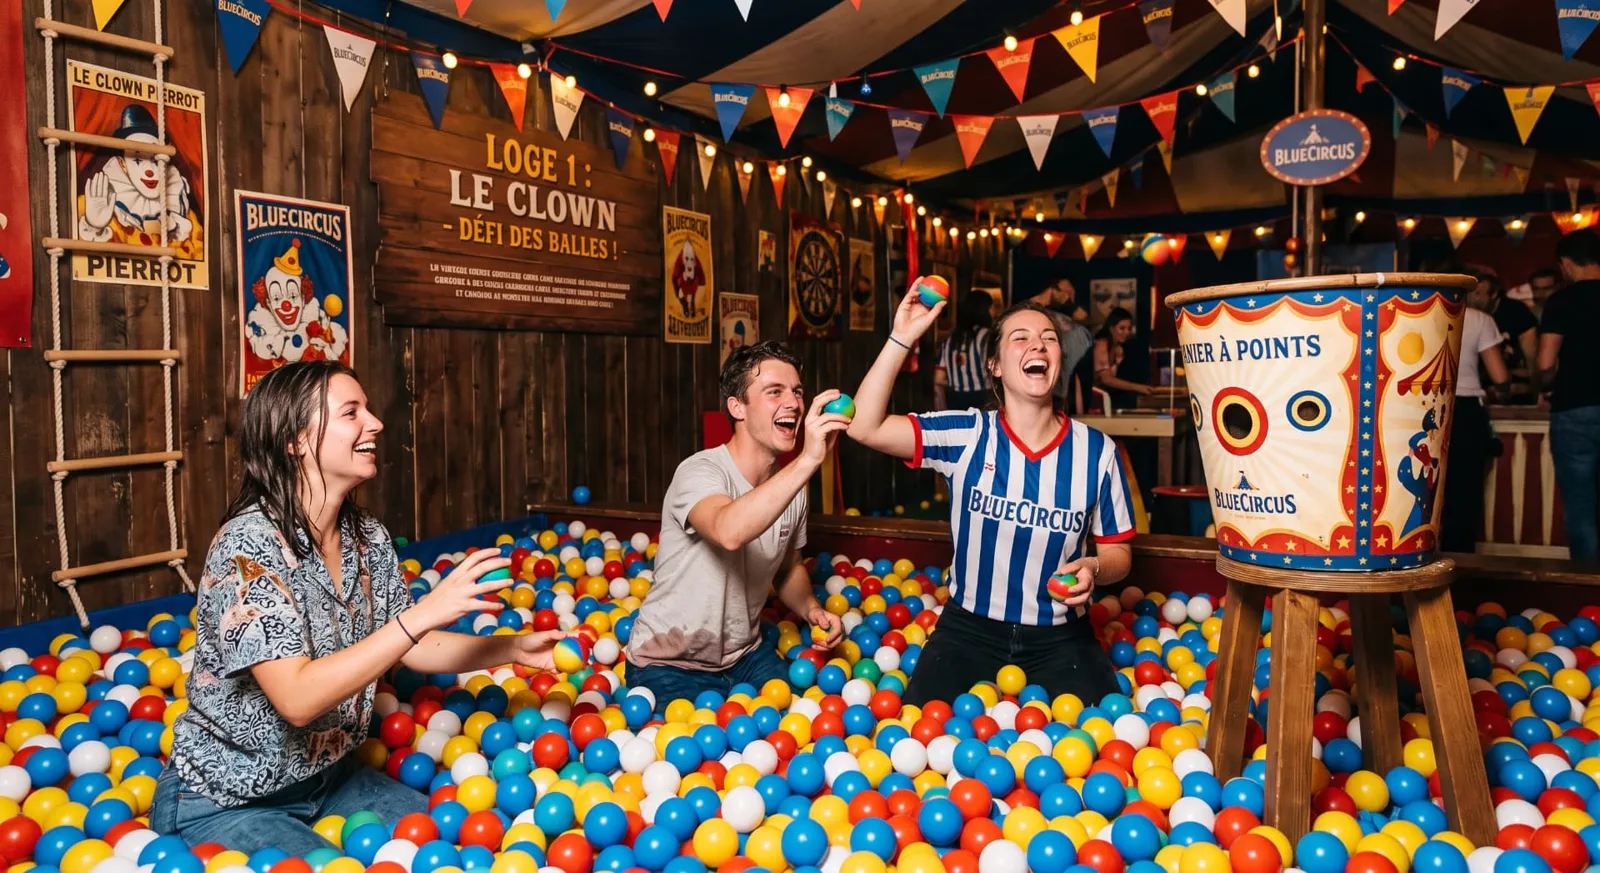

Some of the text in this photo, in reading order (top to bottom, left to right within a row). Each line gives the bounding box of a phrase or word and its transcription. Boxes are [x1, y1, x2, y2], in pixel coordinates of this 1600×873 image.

[74, 67, 90, 85] LE
[95, 73, 143, 97] CLOWN
[485, 133, 557, 182] LOGE
[567, 155, 577, 187] 1
[1274, 143, 1355, 167] BLUECIRCUS
[449, 169, 616, 232] LE CLOWN
[246, 203, 342, 242] BLUECIRCUS
[459, 213, 503, 246] DÉFI
[509, 226, 543, 251] DES
[548, 231, 608, 260] BALLES
[87, 255, 196, 284] PIERROT
[1219, 335, 1232, 362] À
[1236, 334, 1321, 361] POINTS
[970, 488, 1084, 533] BLUECIRCUS
[1214, 488, 1297, 515] BLUECIRCUS
